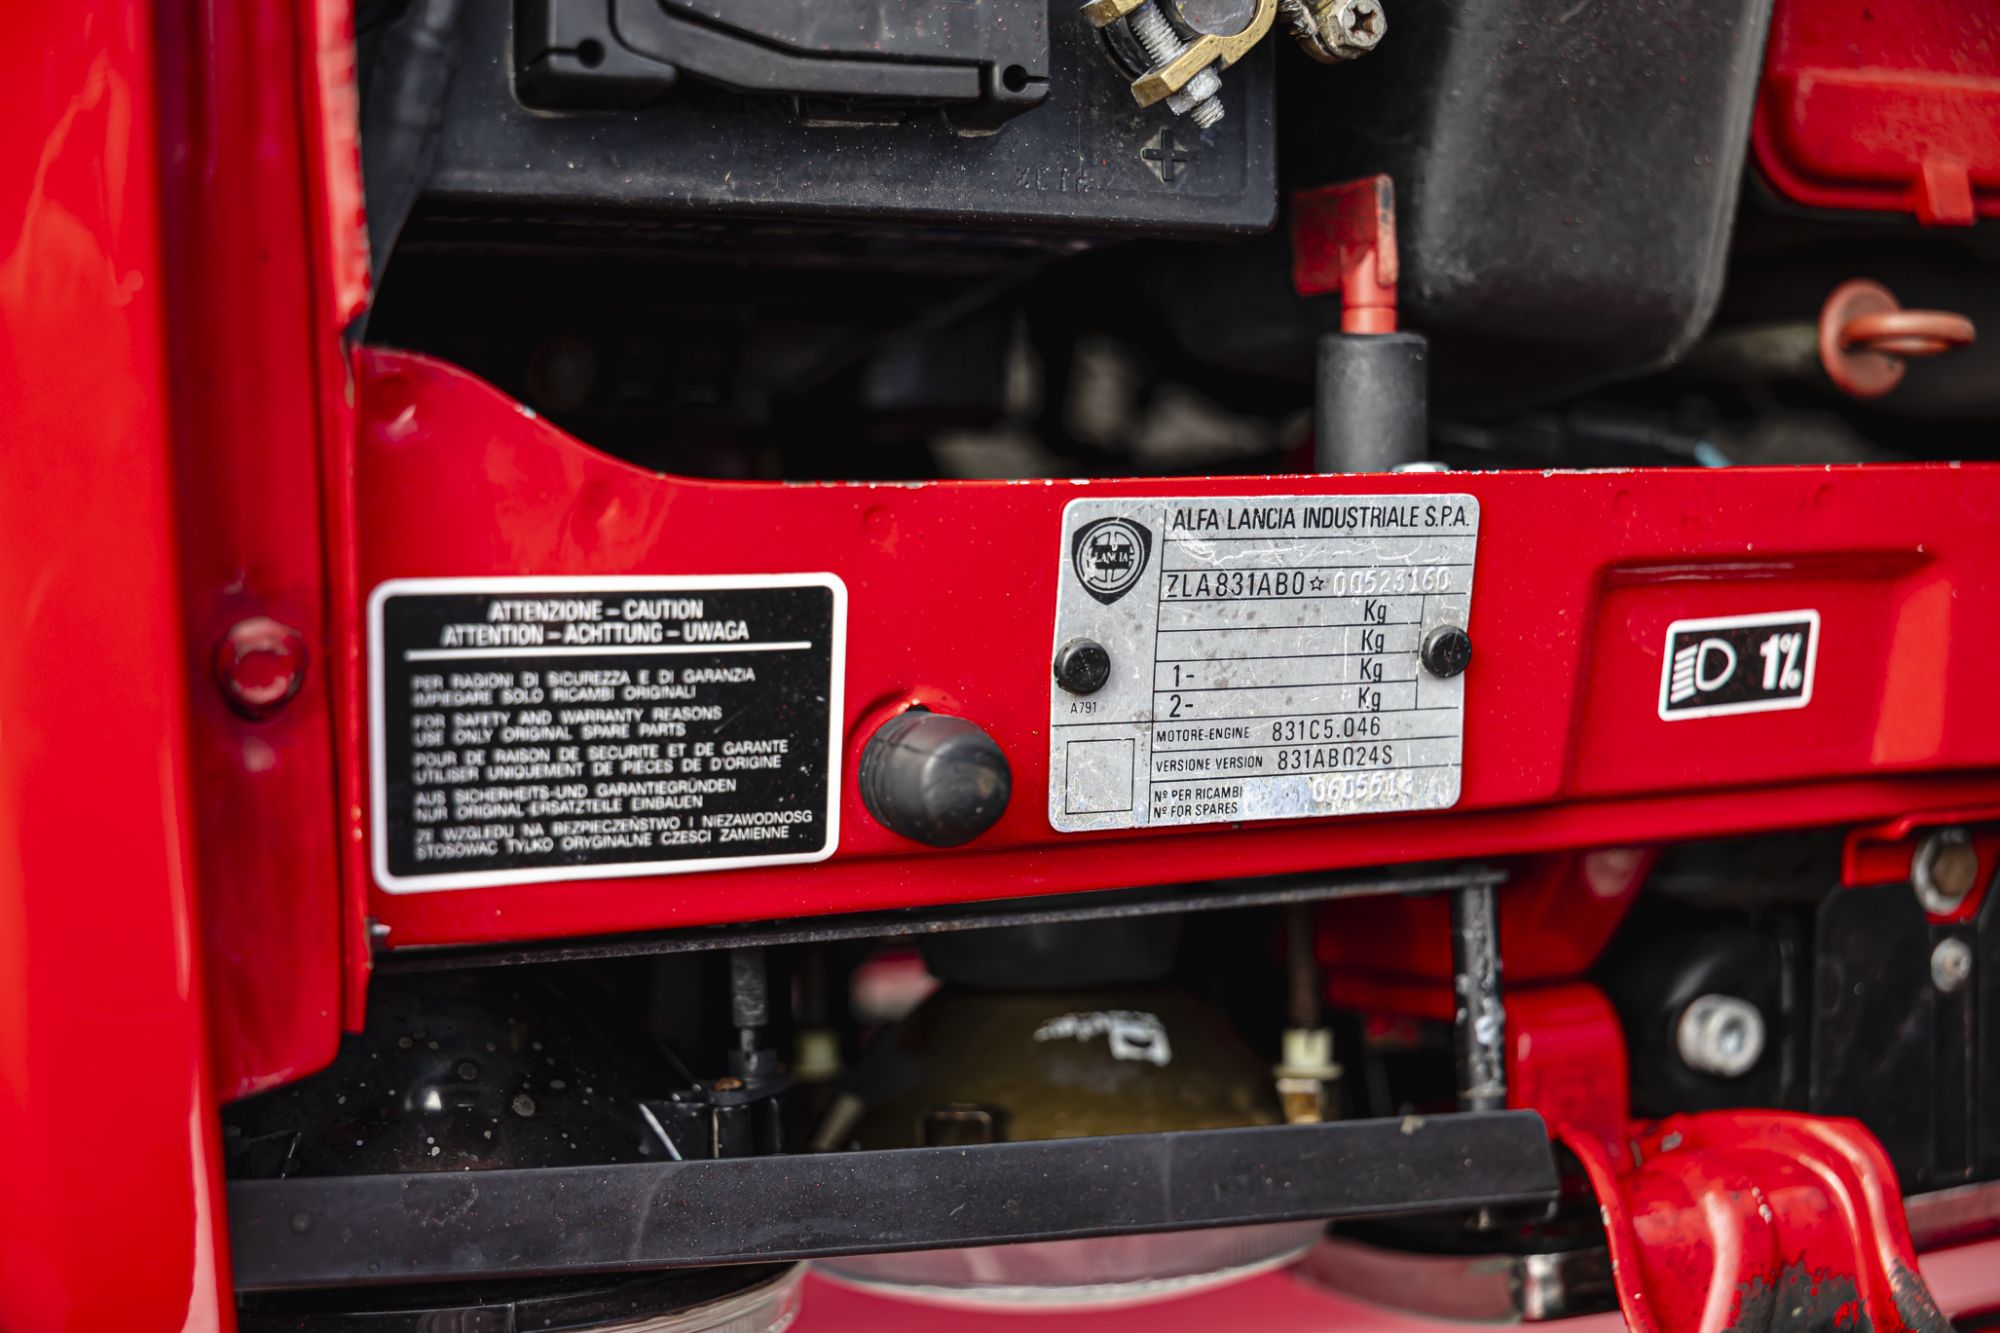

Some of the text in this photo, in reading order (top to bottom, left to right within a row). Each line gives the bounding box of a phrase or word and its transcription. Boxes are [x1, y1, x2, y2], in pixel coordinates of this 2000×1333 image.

[1172, 505, 1470, 530] ALFA LANCIA INDUSTRIALE S.P.A.
[487, 600, 603, 622] ATTENZIONE
[622, 598, 704, 621] CAUTION
[1363, 599, 1387, 624] Kg
[440, 623, 544, 647] ATTENTION
[563, 621, 663, 645] ACHTTUNG
[682, 620, 749, 643] UWAGA
[1361, 629, 1385, 654] Kg
[1360, 657, 1383, 683] Kg
[1760, 632, 1803, 690] 1%
[411, 667, 756, 691] PER RAGIONI DI SICUREZZA E DI GARANZIA
[412, 685, 697, 707] IMPIEGARE SOLO RICAMBI ORIGINALI
[1070, 701, 1097, 714] A791
[1358, 686, 1381, 712] Kg
[411, 705, 723, 730] FOR SAFETY AND WARRANTY REASONS
[1156, 716, 1380, 742] MOTORE-ENGINE 831C5.046
[412, 722, 686, 747] USE ONLY ORIGINAL SPARE PARTS
[412, 751, 457, 767] POUR
[463, 749, 486, 766] DE
[491, 748, 550, 765] RAISON
[557, 746, 580, 762] DE
[667, 743, 687, 758] ET
[694, 742, 715, 757] DE
[722, 739, 789, 756] GARANTE
[1277, 745, 1392, 770] 831AB024S
[413, 766, 479, 785] UTILISER
[484, 762, 584, 781] UNIQUEMENT
[590, 761, 613, 777] DE
[681, 757, 702, 773] DE
[710, 754, 782, 771] D'ORIGINE
[415, 790, 446, 806] AUS
[594, 777, 737, 798] GARANTIEGRÜNDEN
[1171, 788, 1192, 801] PER
[1195, 786, 1243, 800] RICAMBI
[414, 806, 448, 823] NUR
[631, 795, 703, 812] EINBAUEN
[1171, 804, 1192, 817] FOR
[1195, 802, 1238, 816] SPARES
[521, 822, 544, 837] NA
[687, 816, 694, 829] I
[702, 809, 813, 828] NIEZAWODNOSG
[415, 826, 789, 861] STOSOWAC TYLKO ORYGINALNE CZESCI ZAMIENNE
